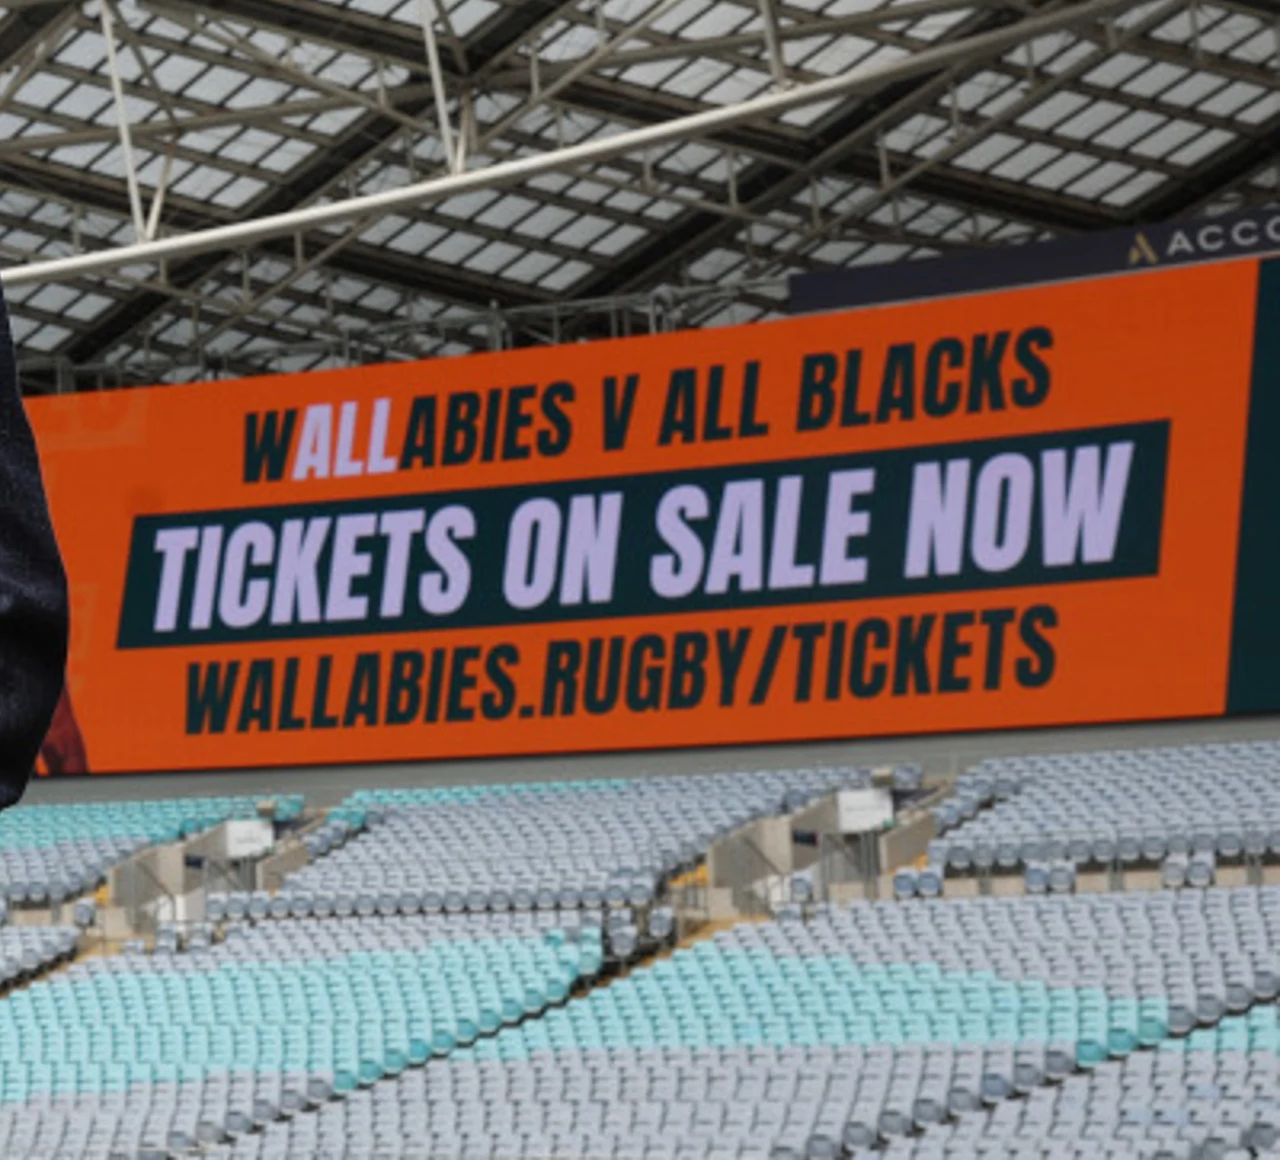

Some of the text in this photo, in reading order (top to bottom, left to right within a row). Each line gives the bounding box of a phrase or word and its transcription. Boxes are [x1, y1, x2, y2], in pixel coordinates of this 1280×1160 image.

[243, 326, 1054, 484] WALLABIES V ALL BLACKS
[153, 441, 1135, 632] TICKETS ON SALE NOW
[185, 604, 1059, 736] WALLABIES.RUGBY/TICKETS
